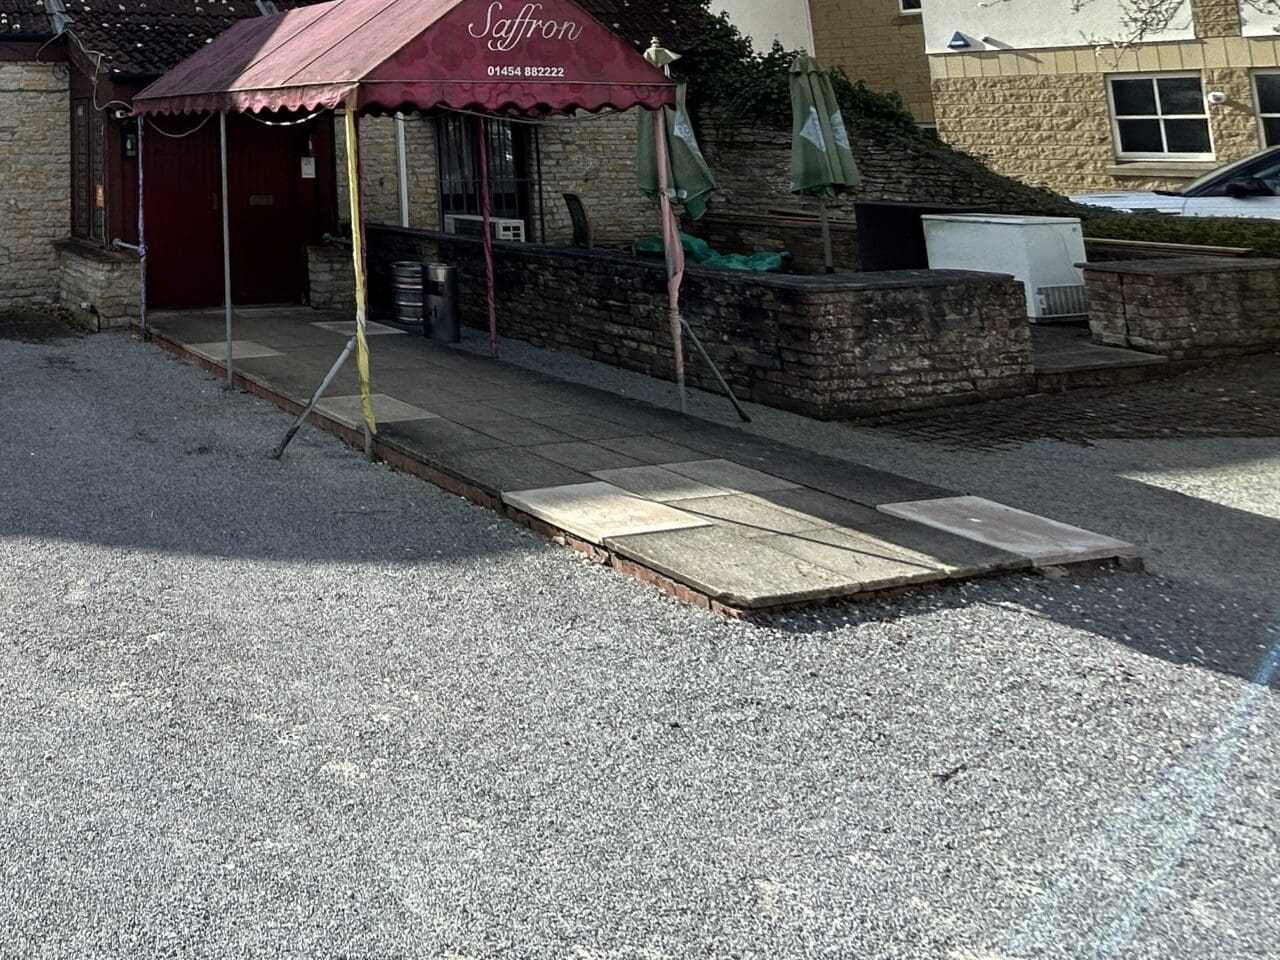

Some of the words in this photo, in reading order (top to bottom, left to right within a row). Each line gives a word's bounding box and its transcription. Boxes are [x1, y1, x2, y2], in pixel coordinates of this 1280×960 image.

[468, 1, 583, 52] Saffron
[487, 66, 522, 76] 01454
[524, 67, 565, 77] 882222
